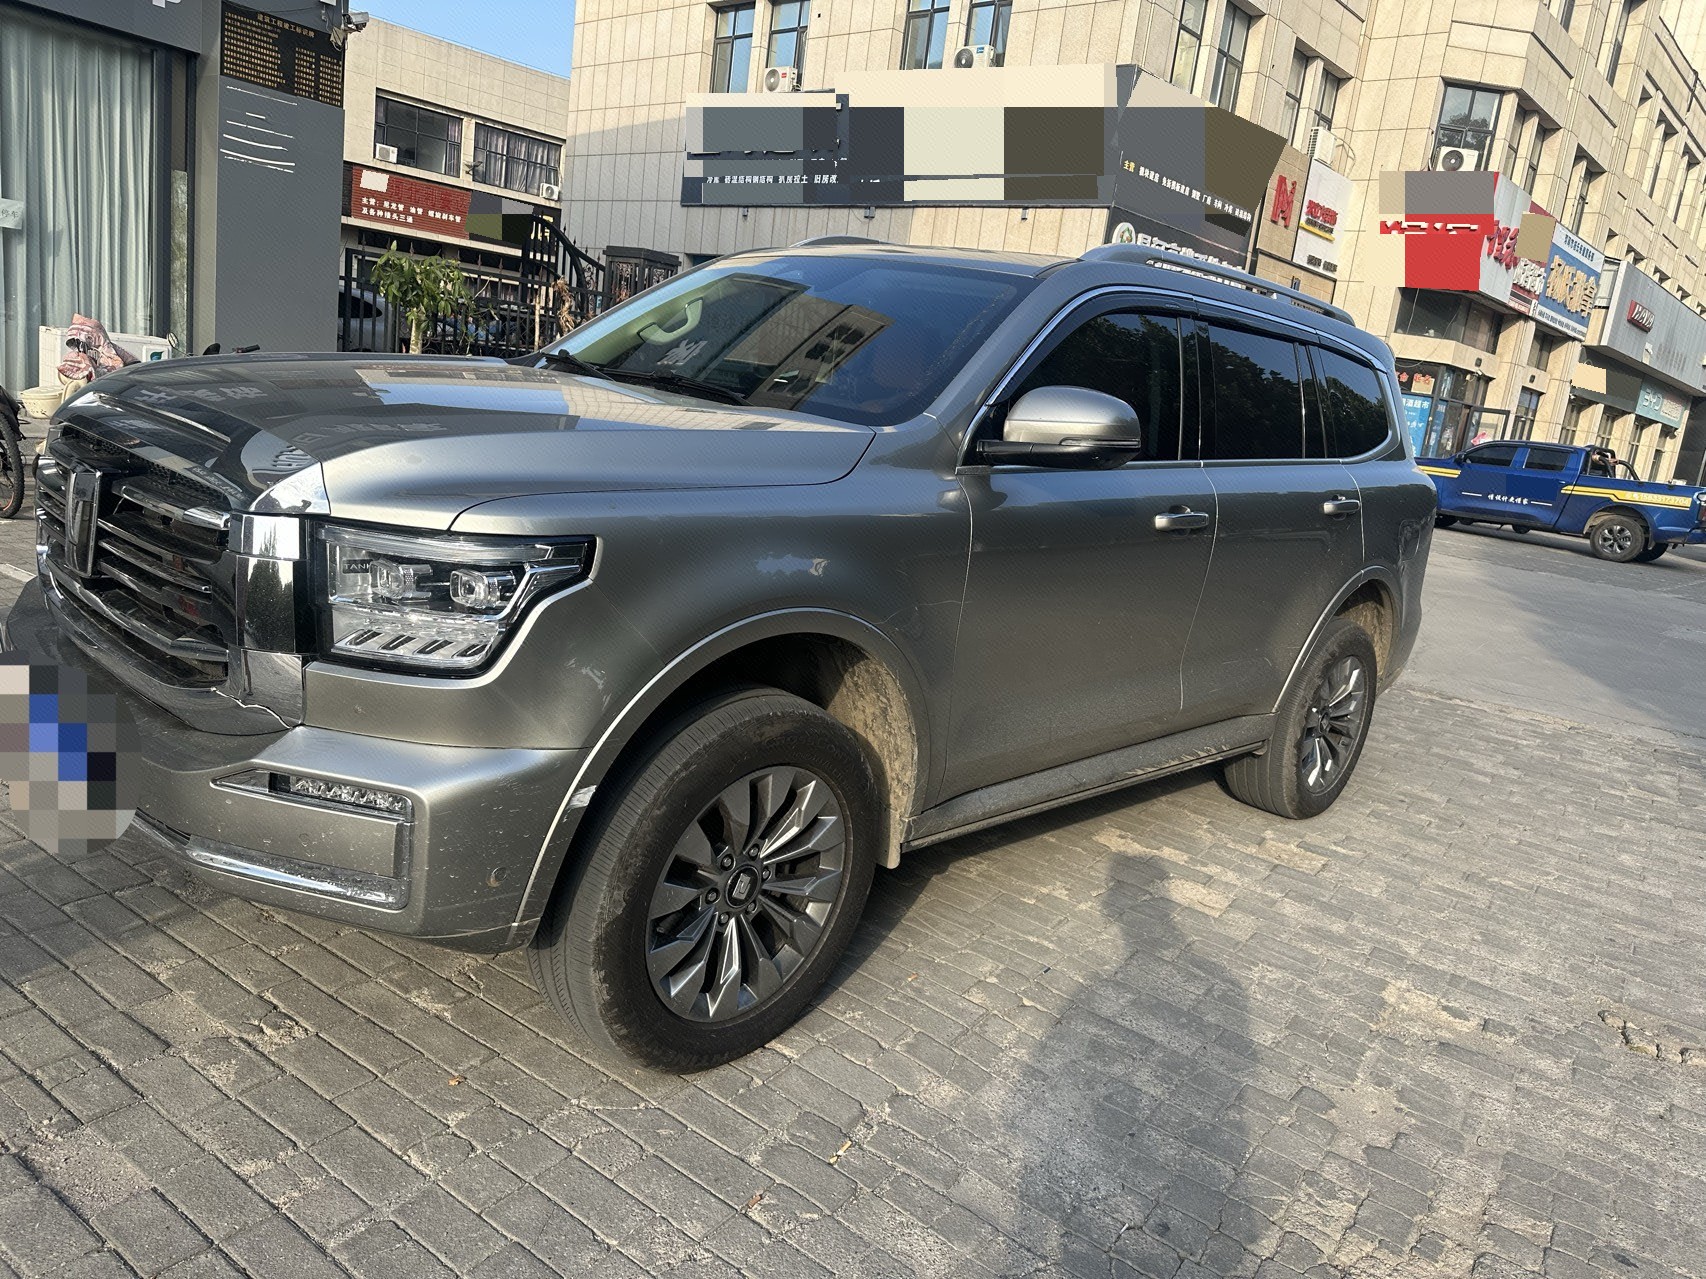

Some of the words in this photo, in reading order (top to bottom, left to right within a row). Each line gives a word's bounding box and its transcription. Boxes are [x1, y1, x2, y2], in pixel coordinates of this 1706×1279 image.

[1123, 160, 1136, 173] 主营
[813, 174, 840, 185] 旧房改
